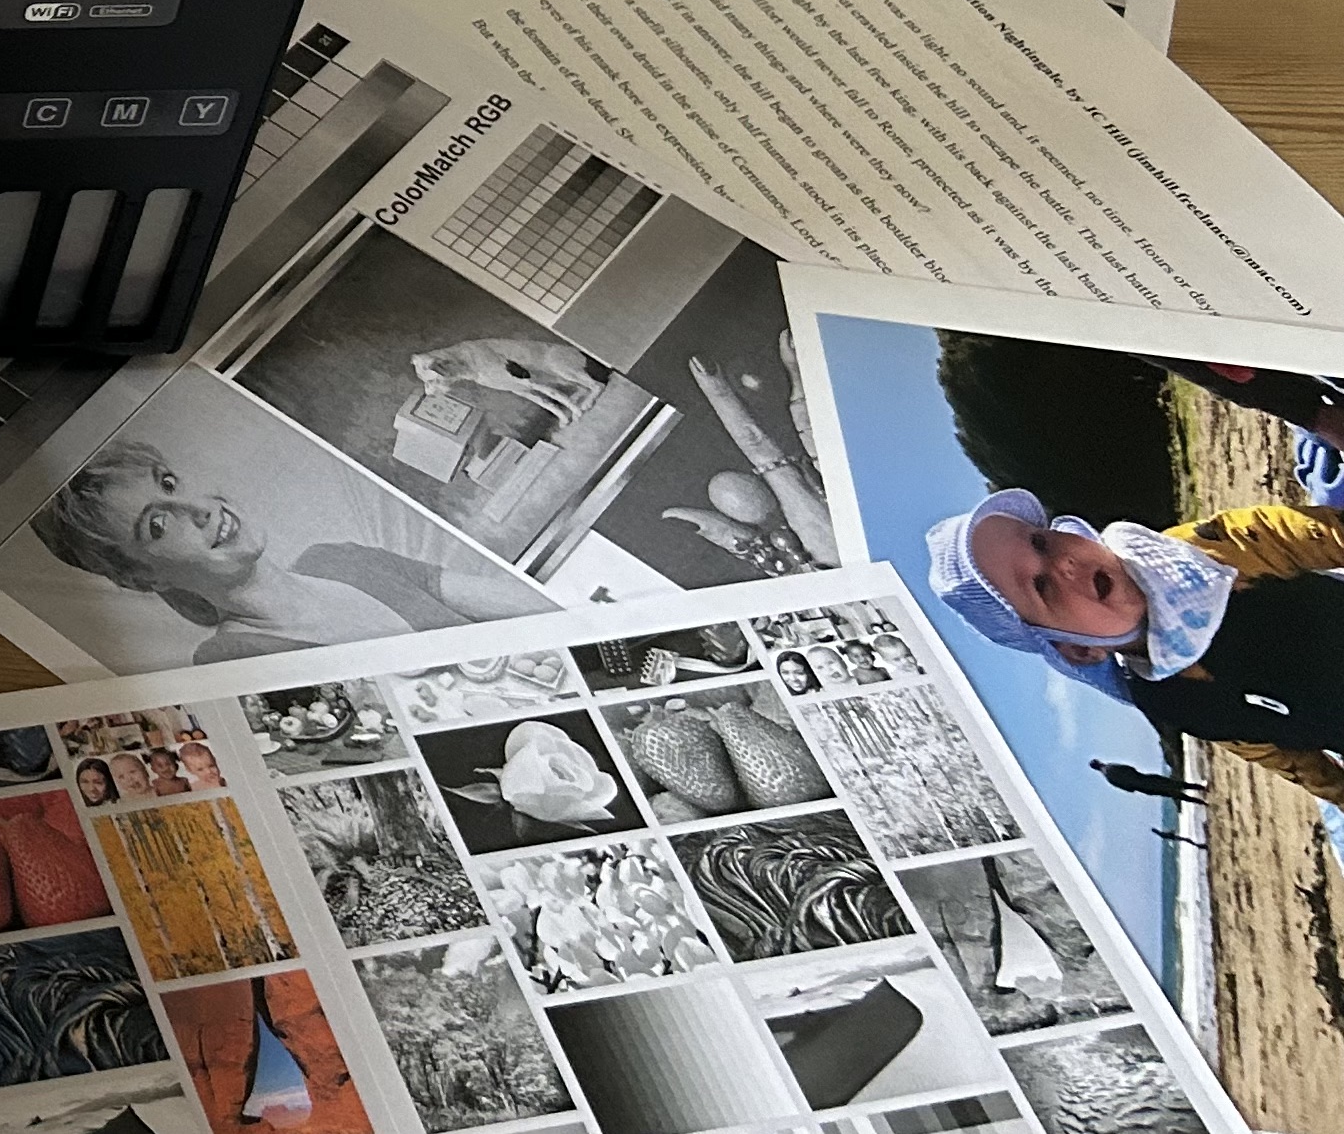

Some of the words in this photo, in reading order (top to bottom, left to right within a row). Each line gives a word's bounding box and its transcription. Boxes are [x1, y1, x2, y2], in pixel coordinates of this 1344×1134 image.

[36, 105, 58, 122] C
[111, 104, 139, 121] M
[196, 102, 216, 120] Y
[993, 22, 1064, 89] Nightingale,
[1065, 88, 1086, 103] by
[1082, 106, 1108, 123] JC
[1101, 123, 1134, 147] Hill
[375, 134, 476, 226] ColorMatch
[464, 93, 512, 135] RGB
